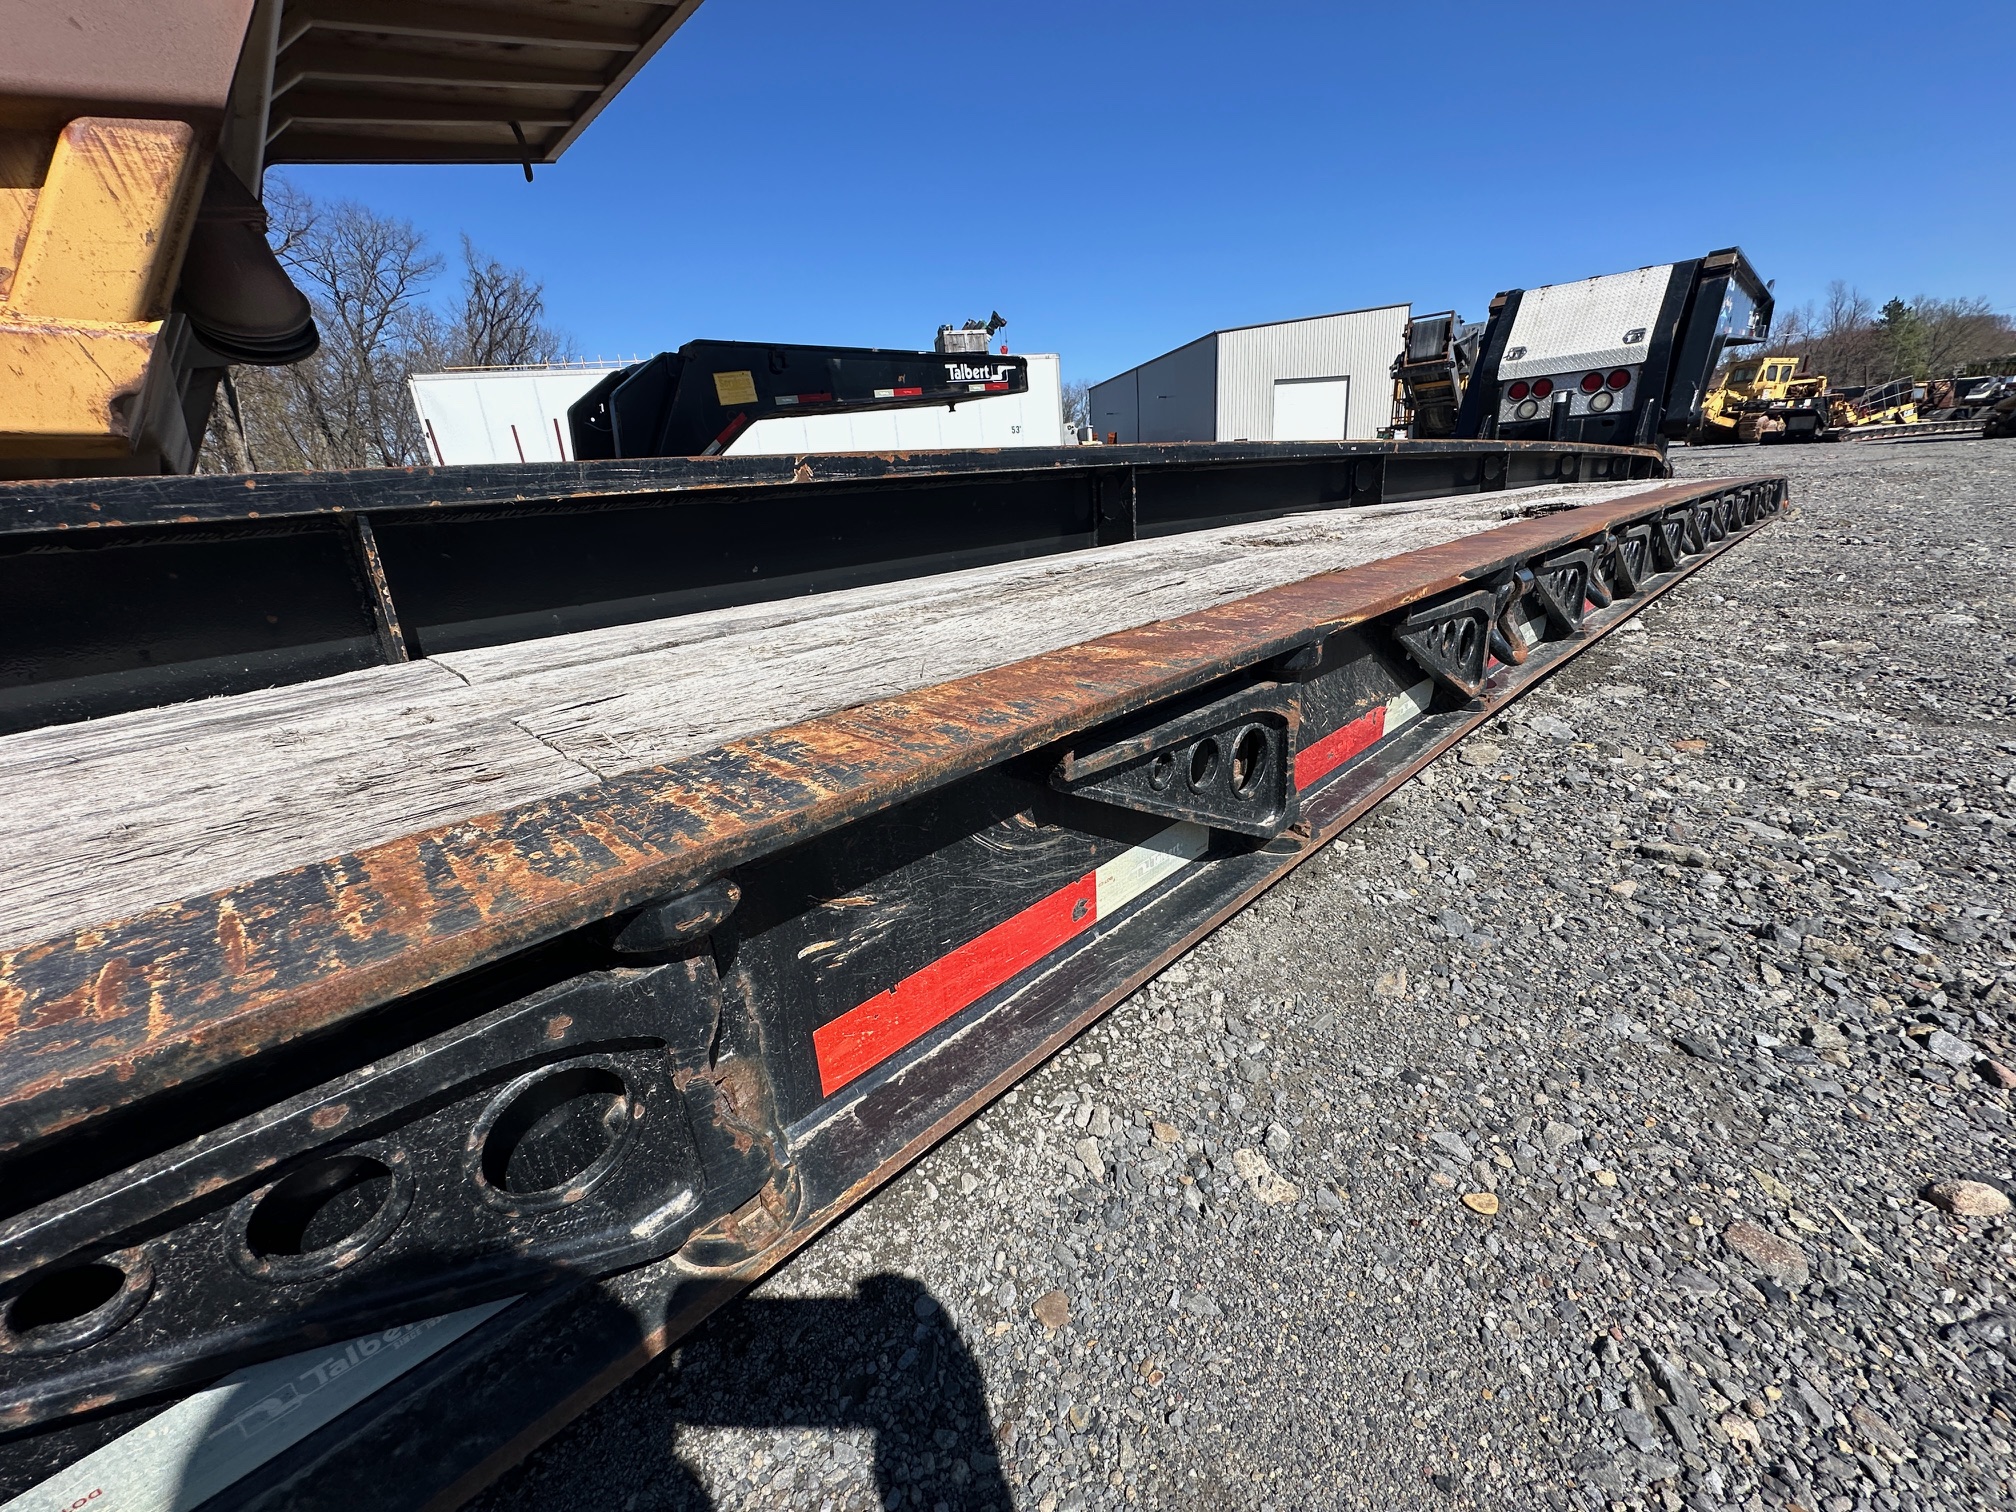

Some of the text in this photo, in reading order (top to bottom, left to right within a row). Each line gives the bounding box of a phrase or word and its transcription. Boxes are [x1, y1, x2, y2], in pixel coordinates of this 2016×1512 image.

[944, 364, 991, 380] Talbert
[392, 1328, 423, 1351] SINCE
[299, 1323, 415, 1386] Talbe
